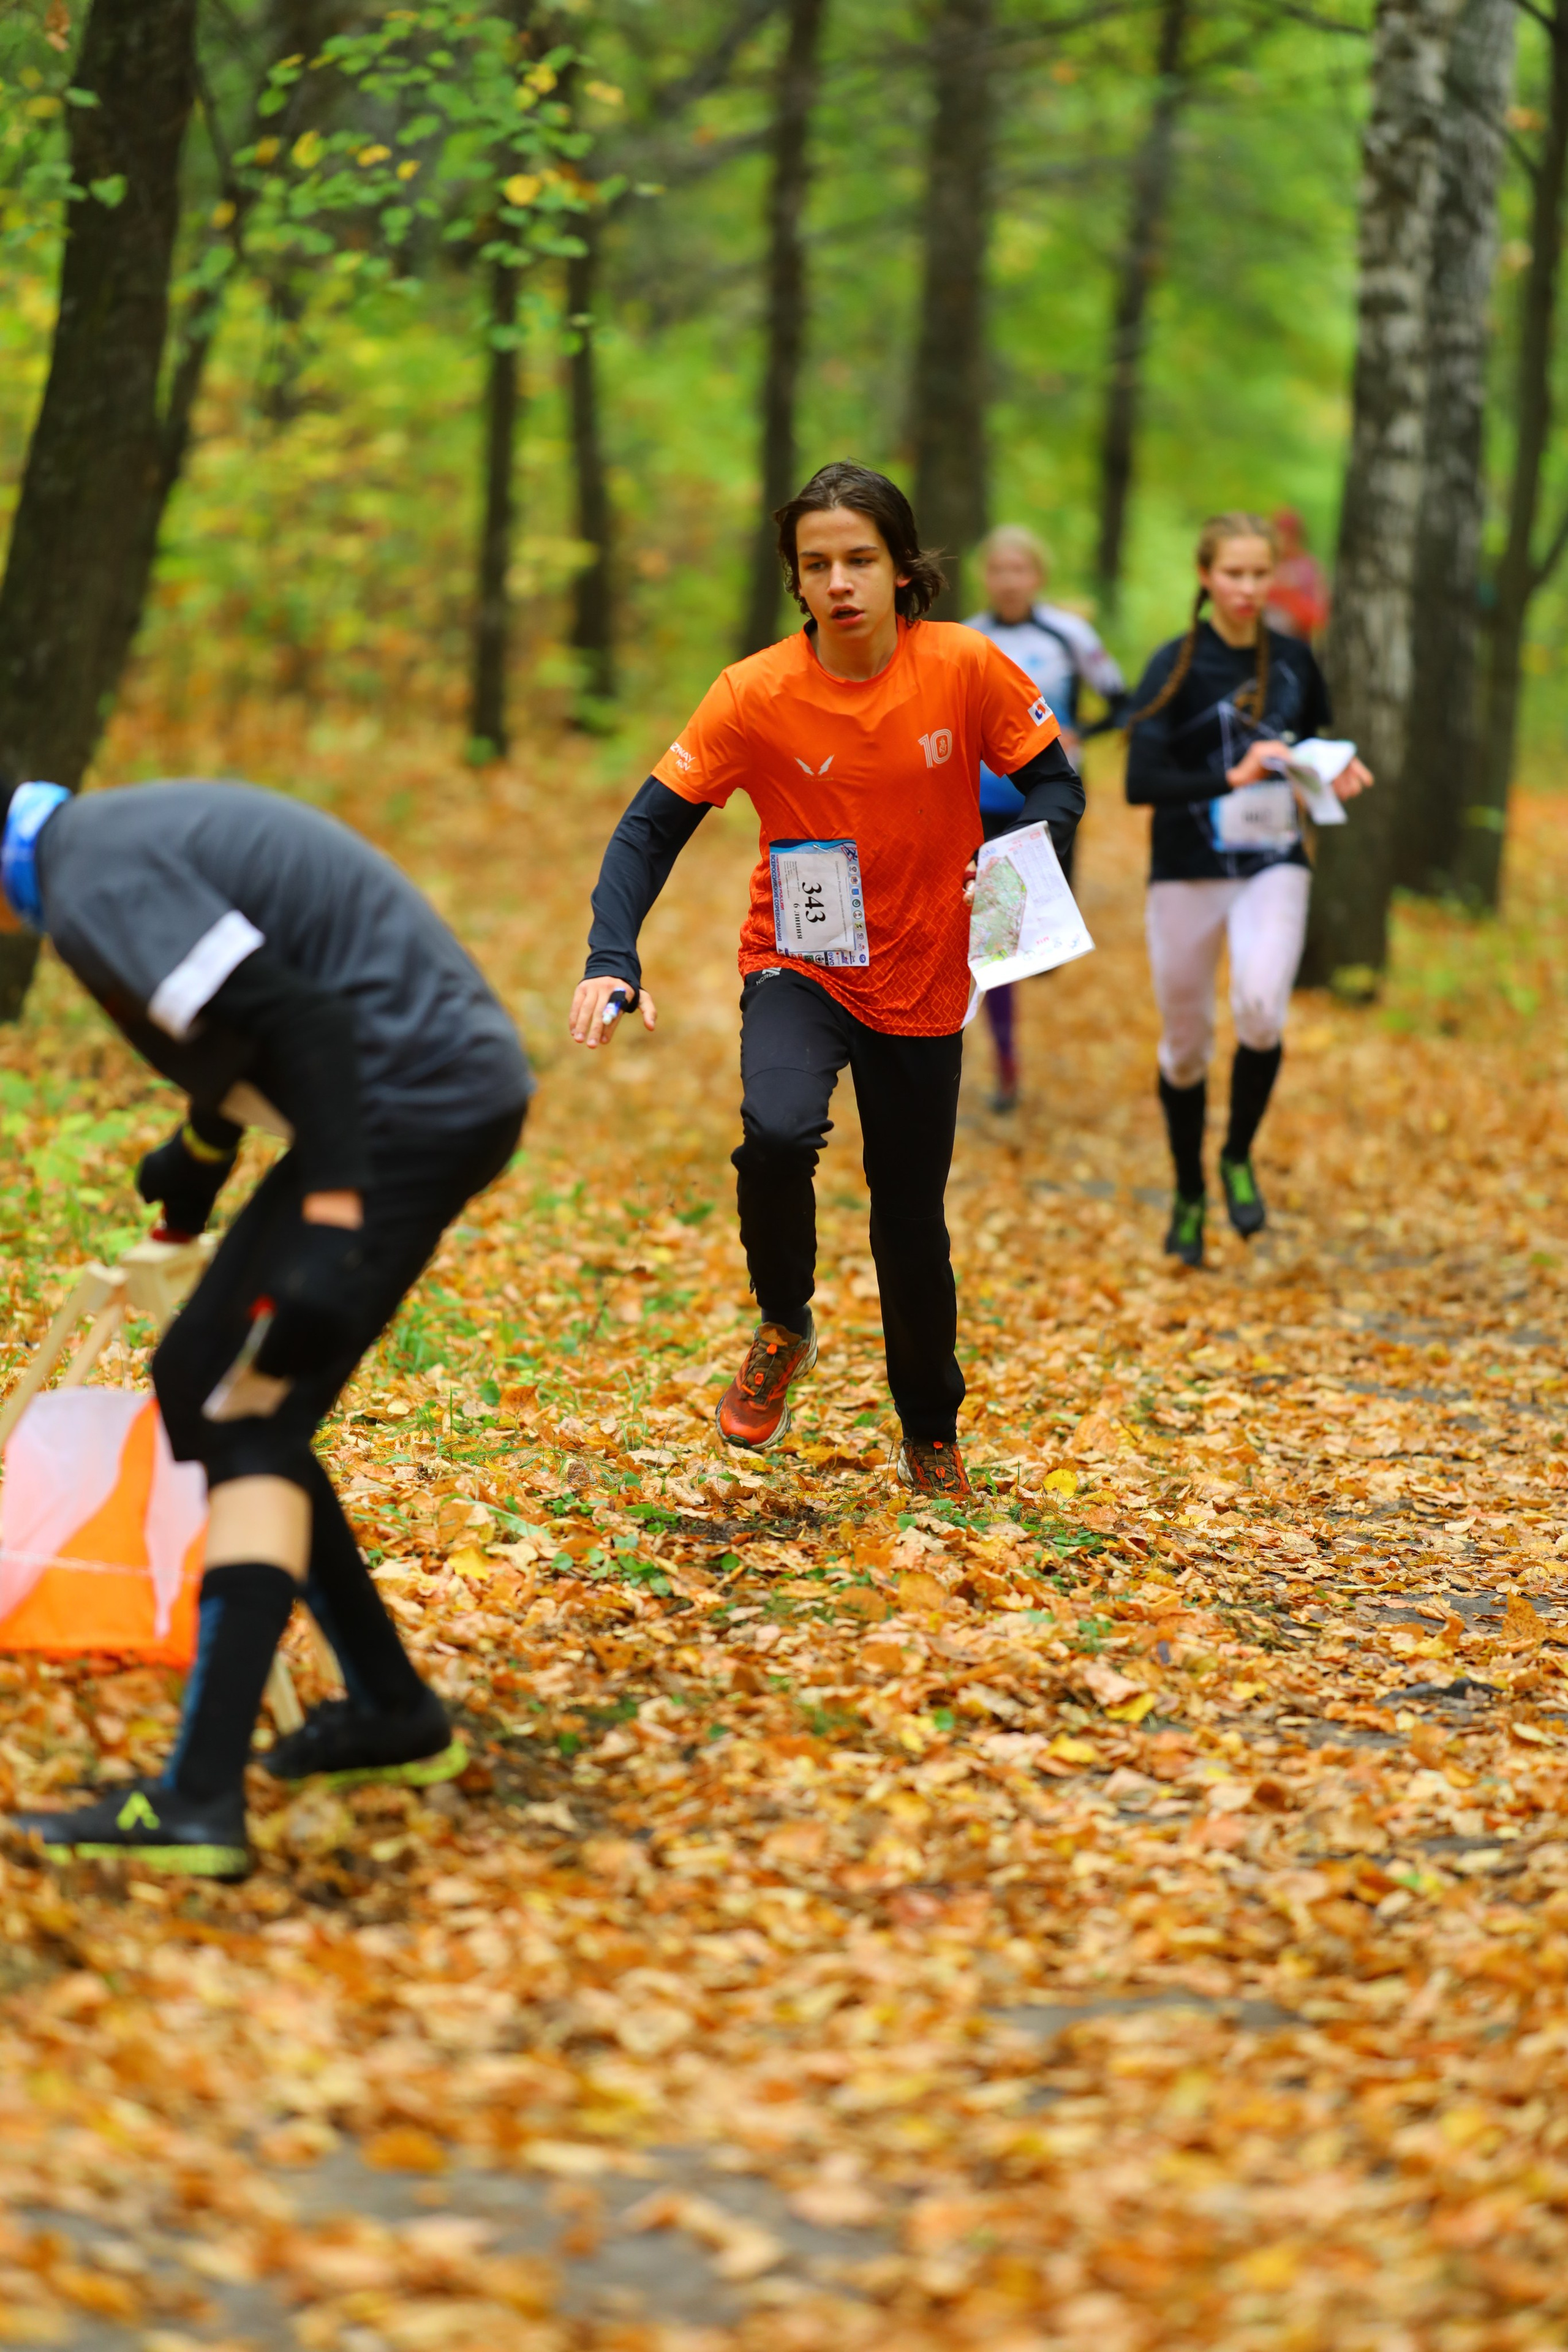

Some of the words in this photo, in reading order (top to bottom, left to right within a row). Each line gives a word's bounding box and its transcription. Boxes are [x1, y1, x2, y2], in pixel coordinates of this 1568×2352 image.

[676, 759, 691, 771] RUN
[918, 728, 952, 769] 10
[802, 882, 826, 924] 343
